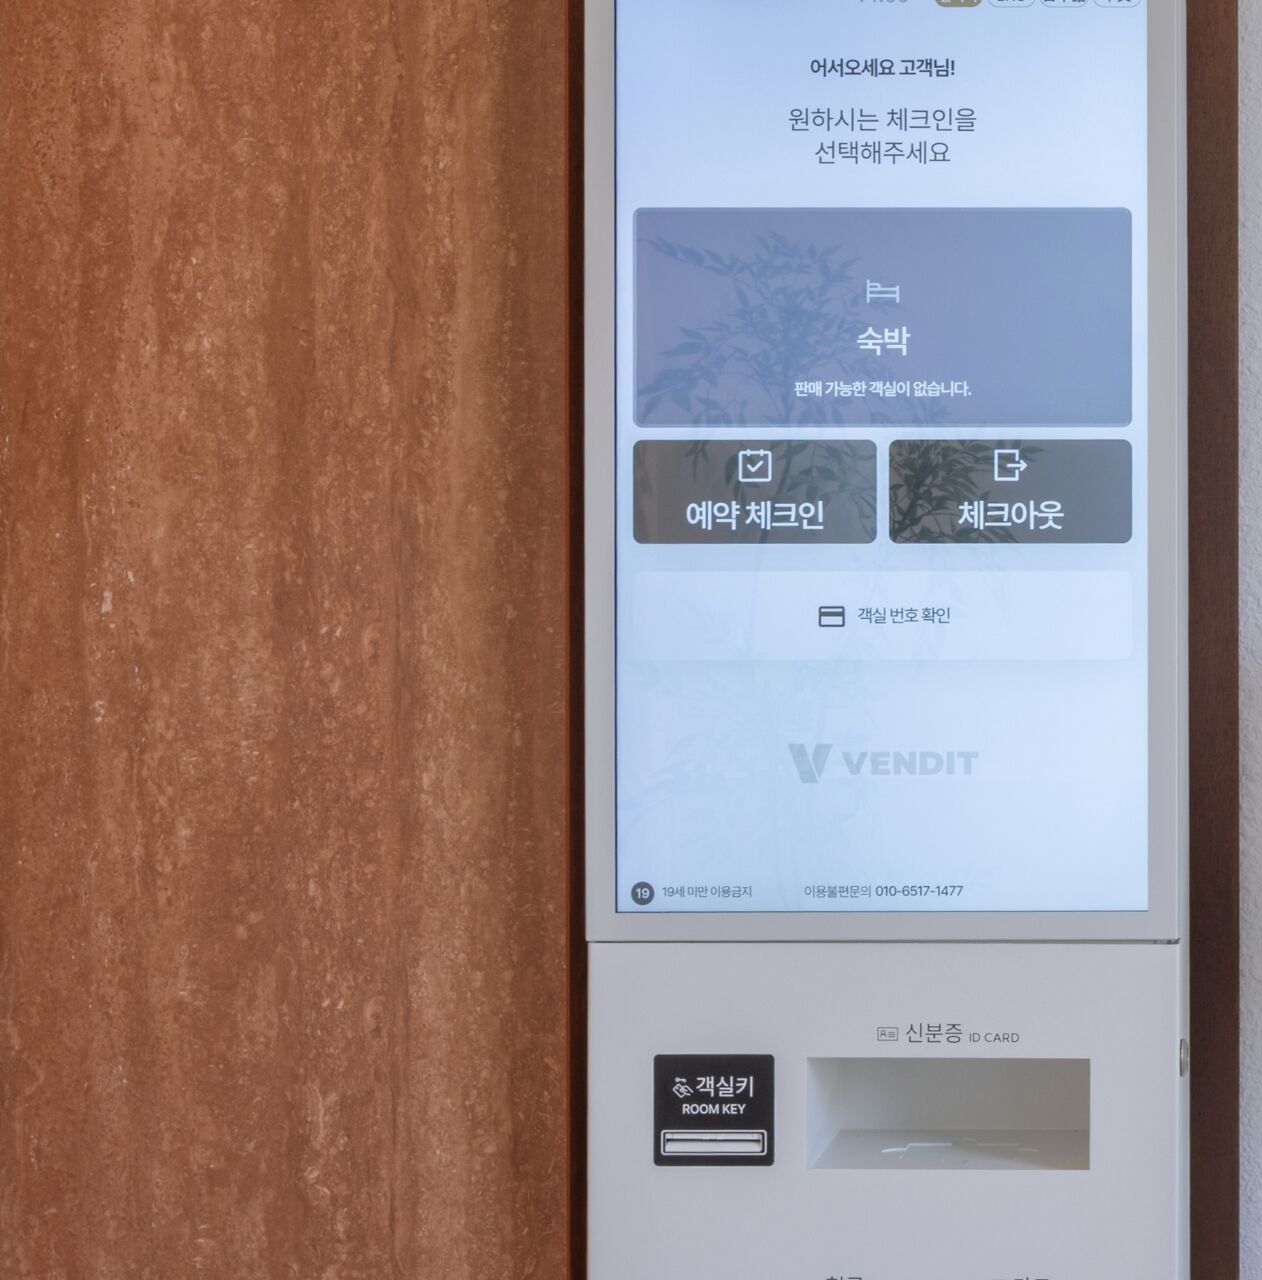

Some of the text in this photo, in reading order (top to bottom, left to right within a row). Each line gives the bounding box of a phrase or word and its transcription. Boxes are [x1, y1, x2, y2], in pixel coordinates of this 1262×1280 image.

[811, 58, 954, 77] 어서오세요 고객님!
[789, 108, 976, 131] 원하시는 체크인을
[815, 141, 950, 164] 선택해주세요
[857, 327, 910, 356] 숙박
[794, 381, 971, 397] 판매 가능한 객실이 없습니다.
[687, 501, 824, 530] 예약 체크인
[959, 501, 1065, 530] 체크아웃
[858, 608, 950, 624] 객실 번호 확인
[842, 751, 979, 776] VENDIT
[635, 886, 650, 899] 19
[662, 885, 753, 899] 19세 미만 이용금지
[804, 885, 964, 899] 이용불편문의 010-6517-1477
[906, 1023, 1020, 1043] 신분증 ID CARD
[696, 1076, 753, 1097] 객실키
[682, 1103, 746, 1115] ROOM KEY
